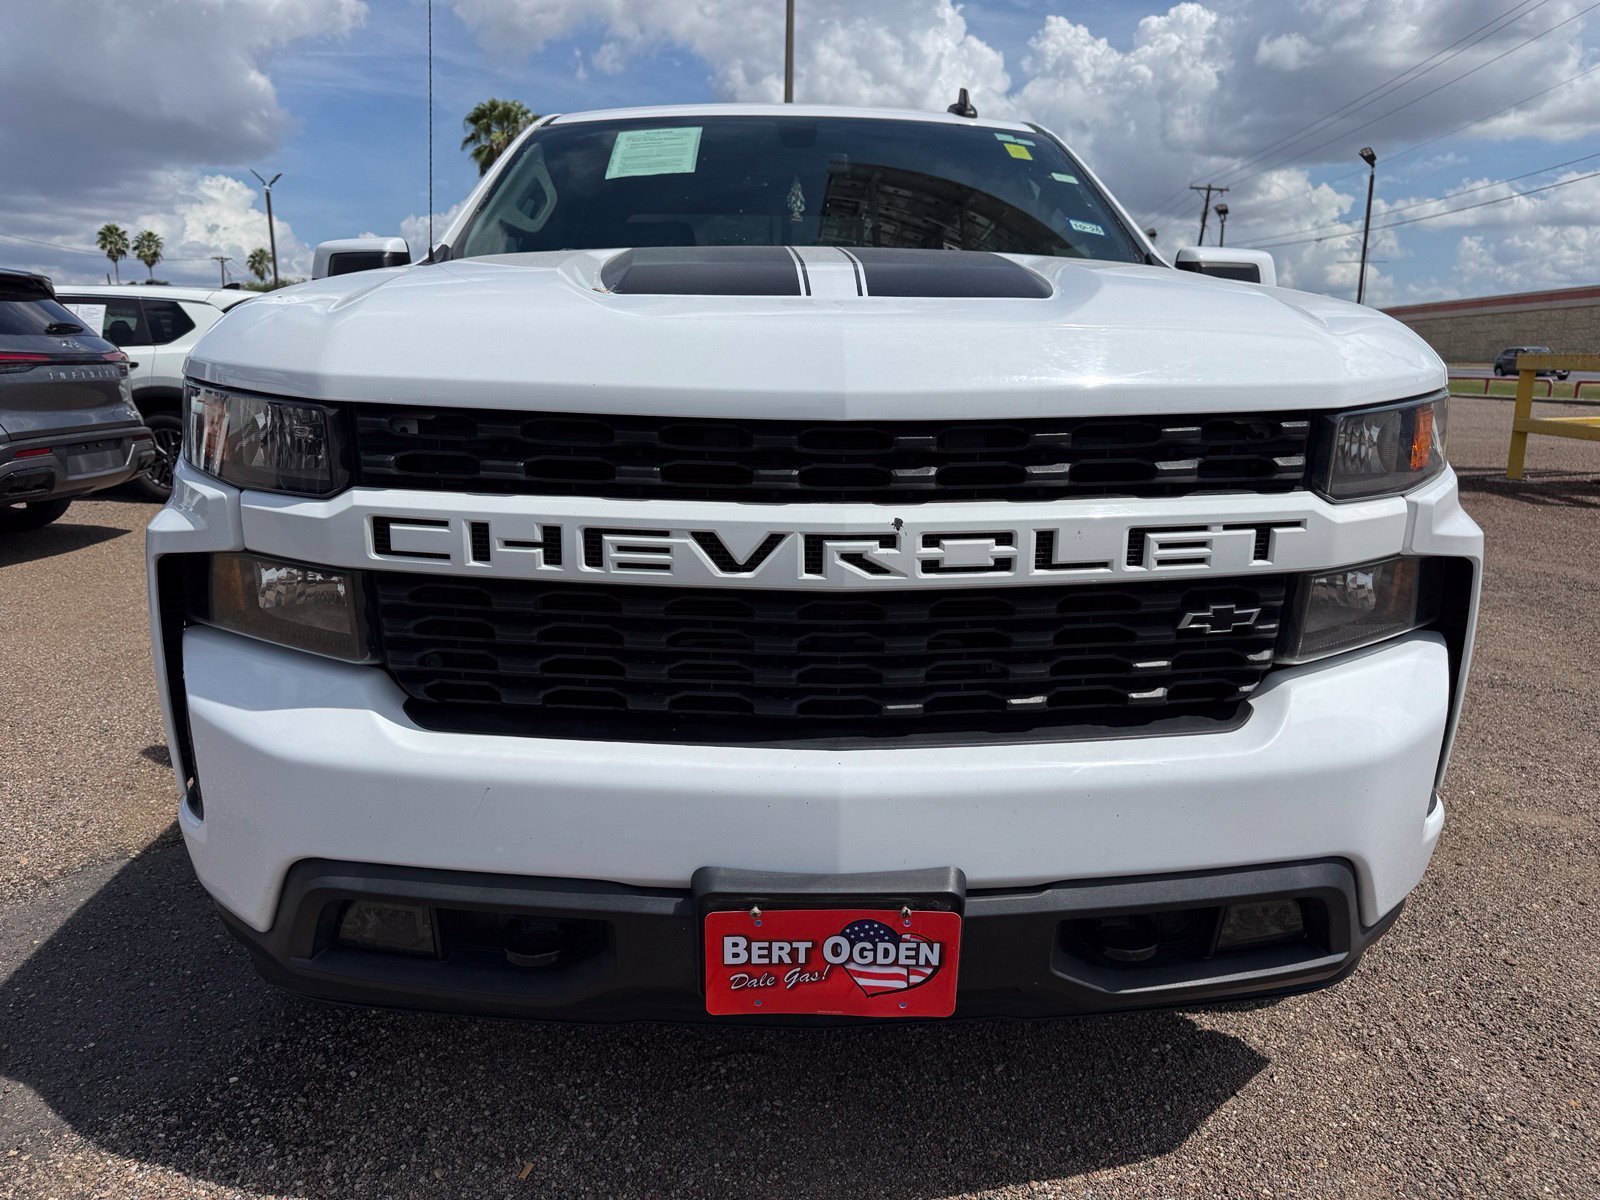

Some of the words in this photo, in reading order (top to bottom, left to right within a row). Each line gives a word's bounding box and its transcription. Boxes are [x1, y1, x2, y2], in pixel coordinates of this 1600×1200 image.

[49, 370, 116, 380] INFINITI
[366, 514, 1306, 578] CHEVROLET
[723, 936, 813, 965] BERT
[822, 935, 941, 966] OGDEN
[730, 972, 775, 989] Dale
[783, 965, 830, 990] Gas!
